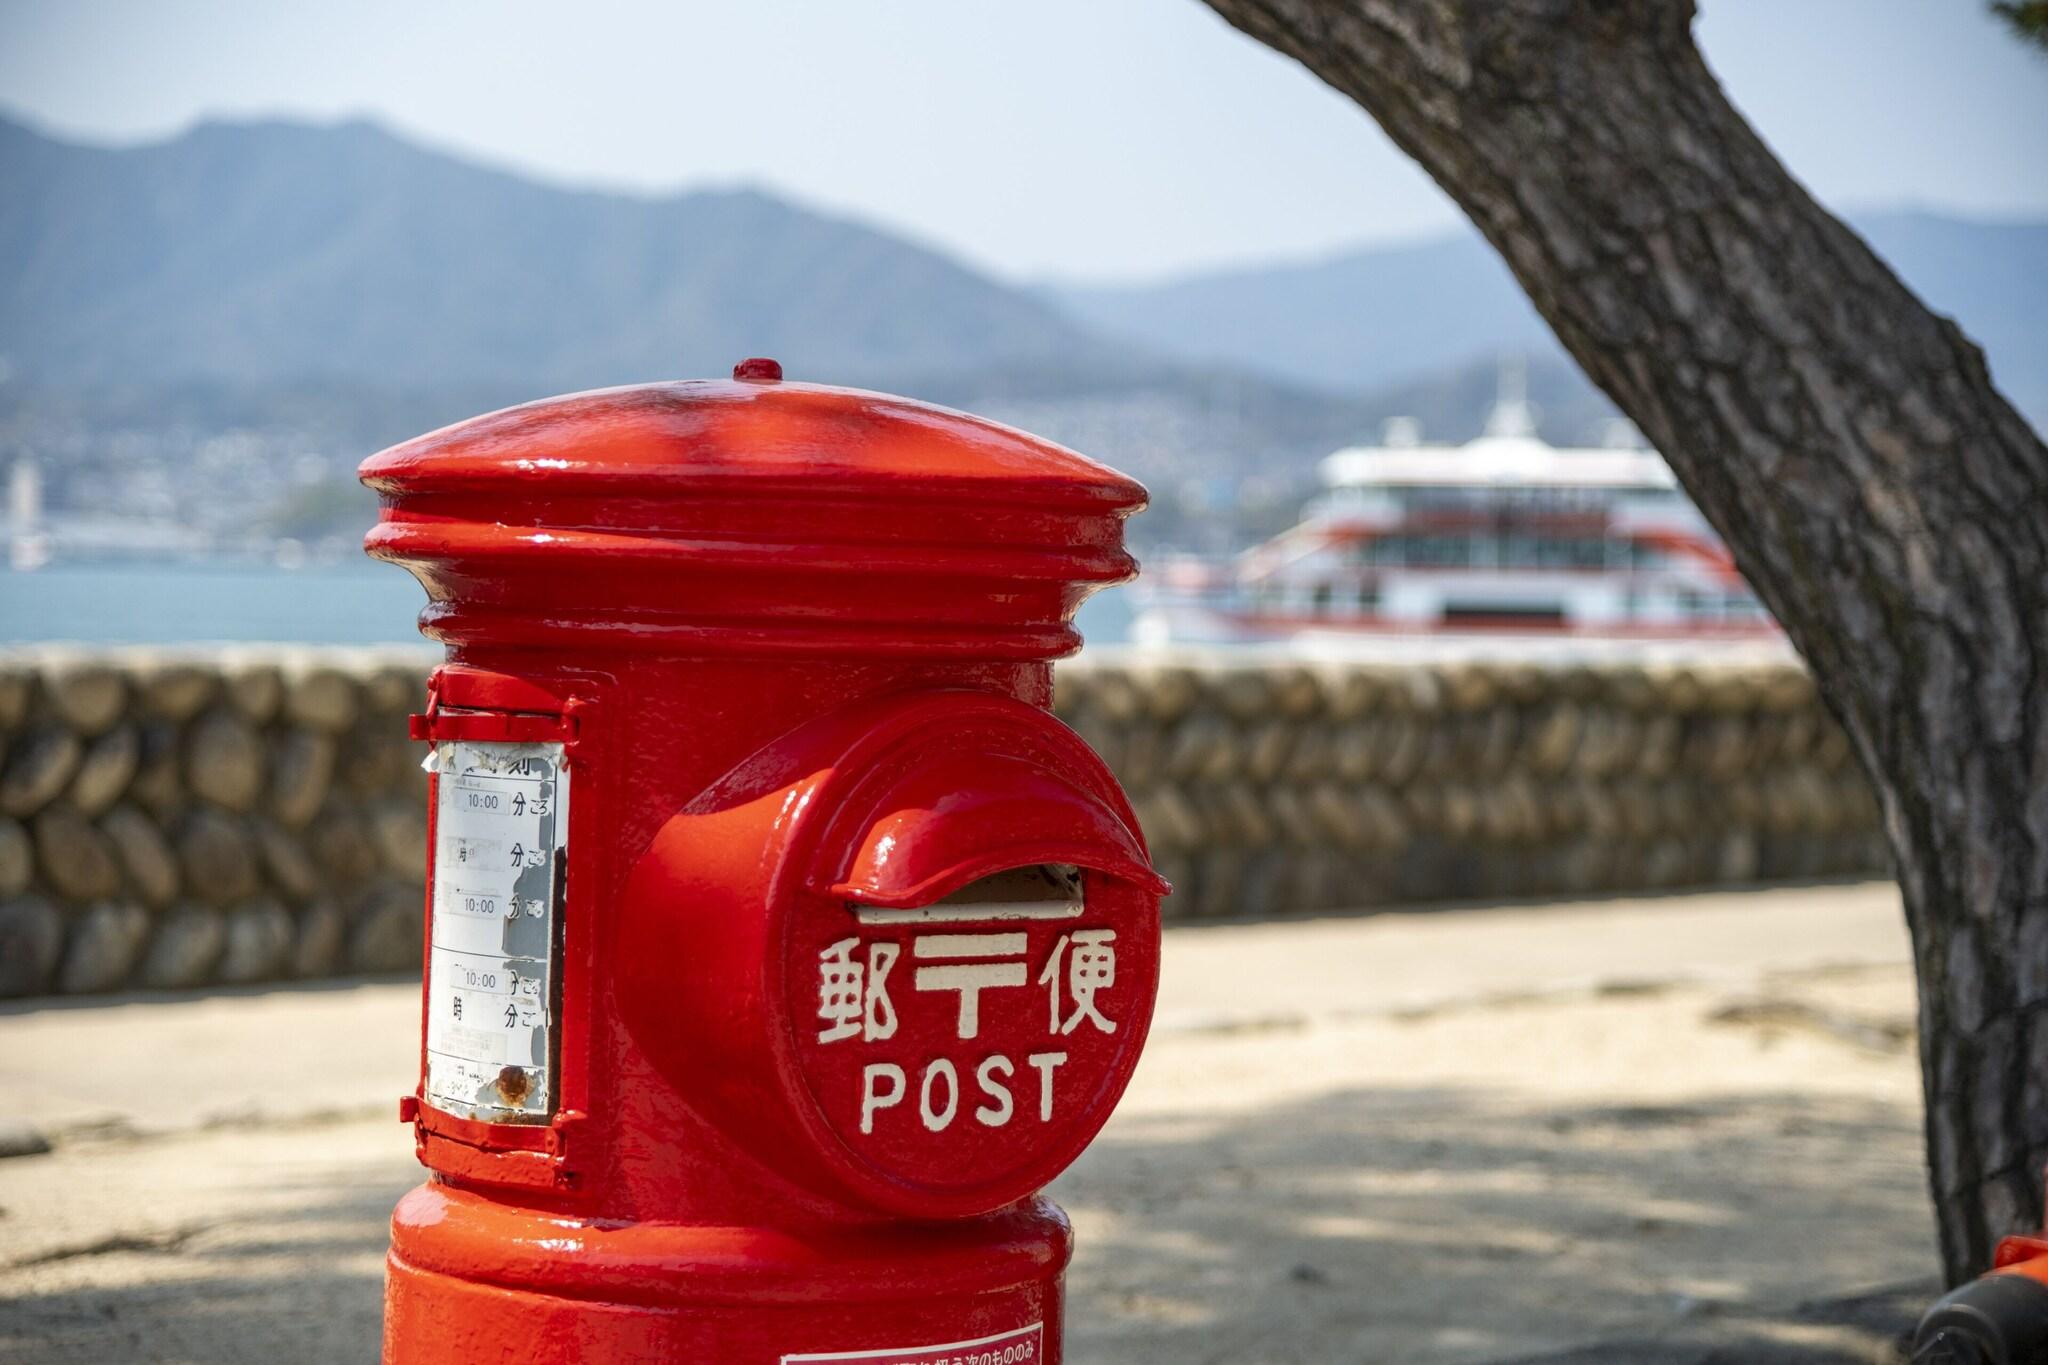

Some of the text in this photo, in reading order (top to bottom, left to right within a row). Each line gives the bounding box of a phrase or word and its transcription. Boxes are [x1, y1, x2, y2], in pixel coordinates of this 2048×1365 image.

[468, 791, 548, 816] 10:00 分ごろ
[510, 842, 546, 867] 分ご
[465, 898, 495, 914] 10:00
[466, 972, 496, 989] 10:00
[860, 1052, 1068, 1135] POST
